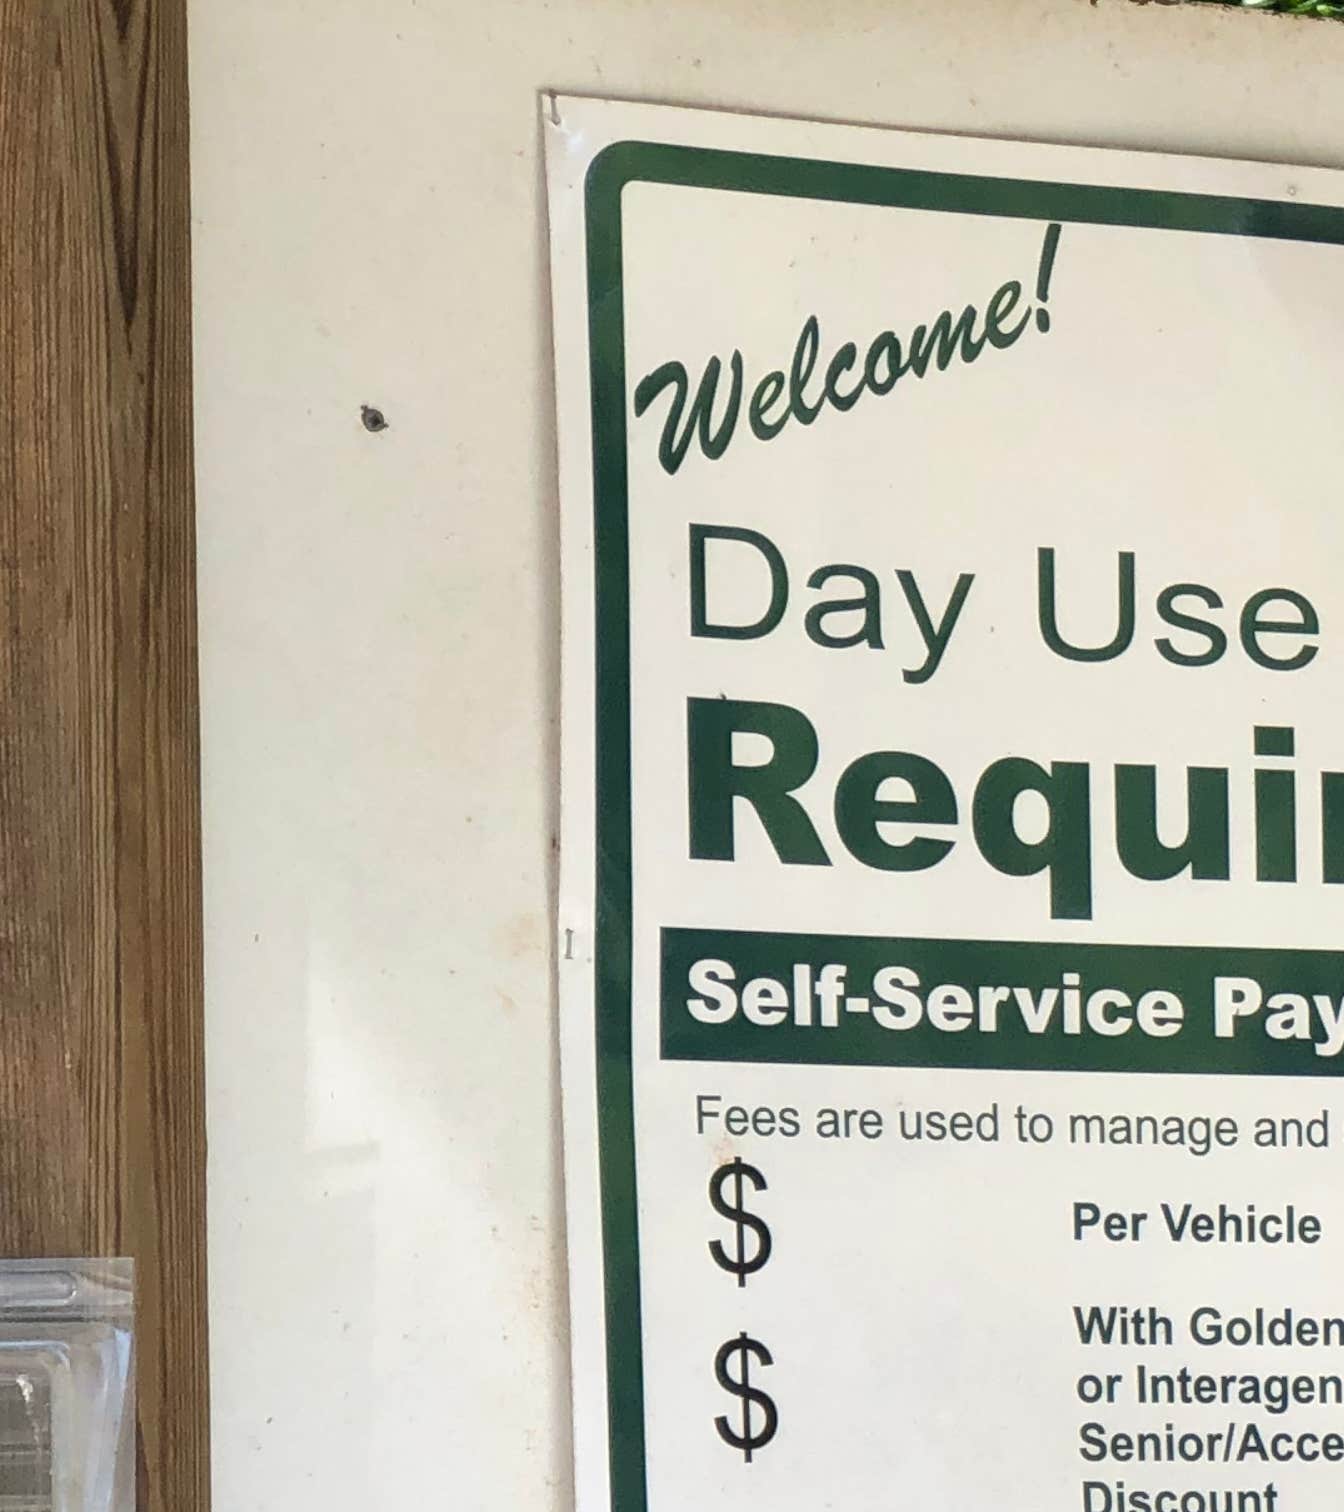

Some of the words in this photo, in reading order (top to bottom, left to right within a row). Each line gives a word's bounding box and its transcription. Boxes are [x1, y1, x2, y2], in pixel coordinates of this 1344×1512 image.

[634, 222, 1063, 476] Welcome!
[688, 521, 976, 684] Day
[1037, 545, 1321, 671] Use
[686, 957, 1185, 1040] Self-Service
[694, 1093, 802, 1140] Fees
[816, 1103, 883, 1141] are
[897, 1103, 1001, 1143] used
[1014, 1105, 1055, 1145] to
[1067, 1113, 1239, 1158] manage
[1253, 1110, 1330, 1150] and
[706, 1156, 773, 1287] $
[1072, 1202, 1148, 1243] Per
[1159, 1203, 1323, 1246] Vehicle
[1073, 1305, 1174, 1347] With
[713, 1332, 780, 1462] $
[1075, 1370, 1121, 1405] or
